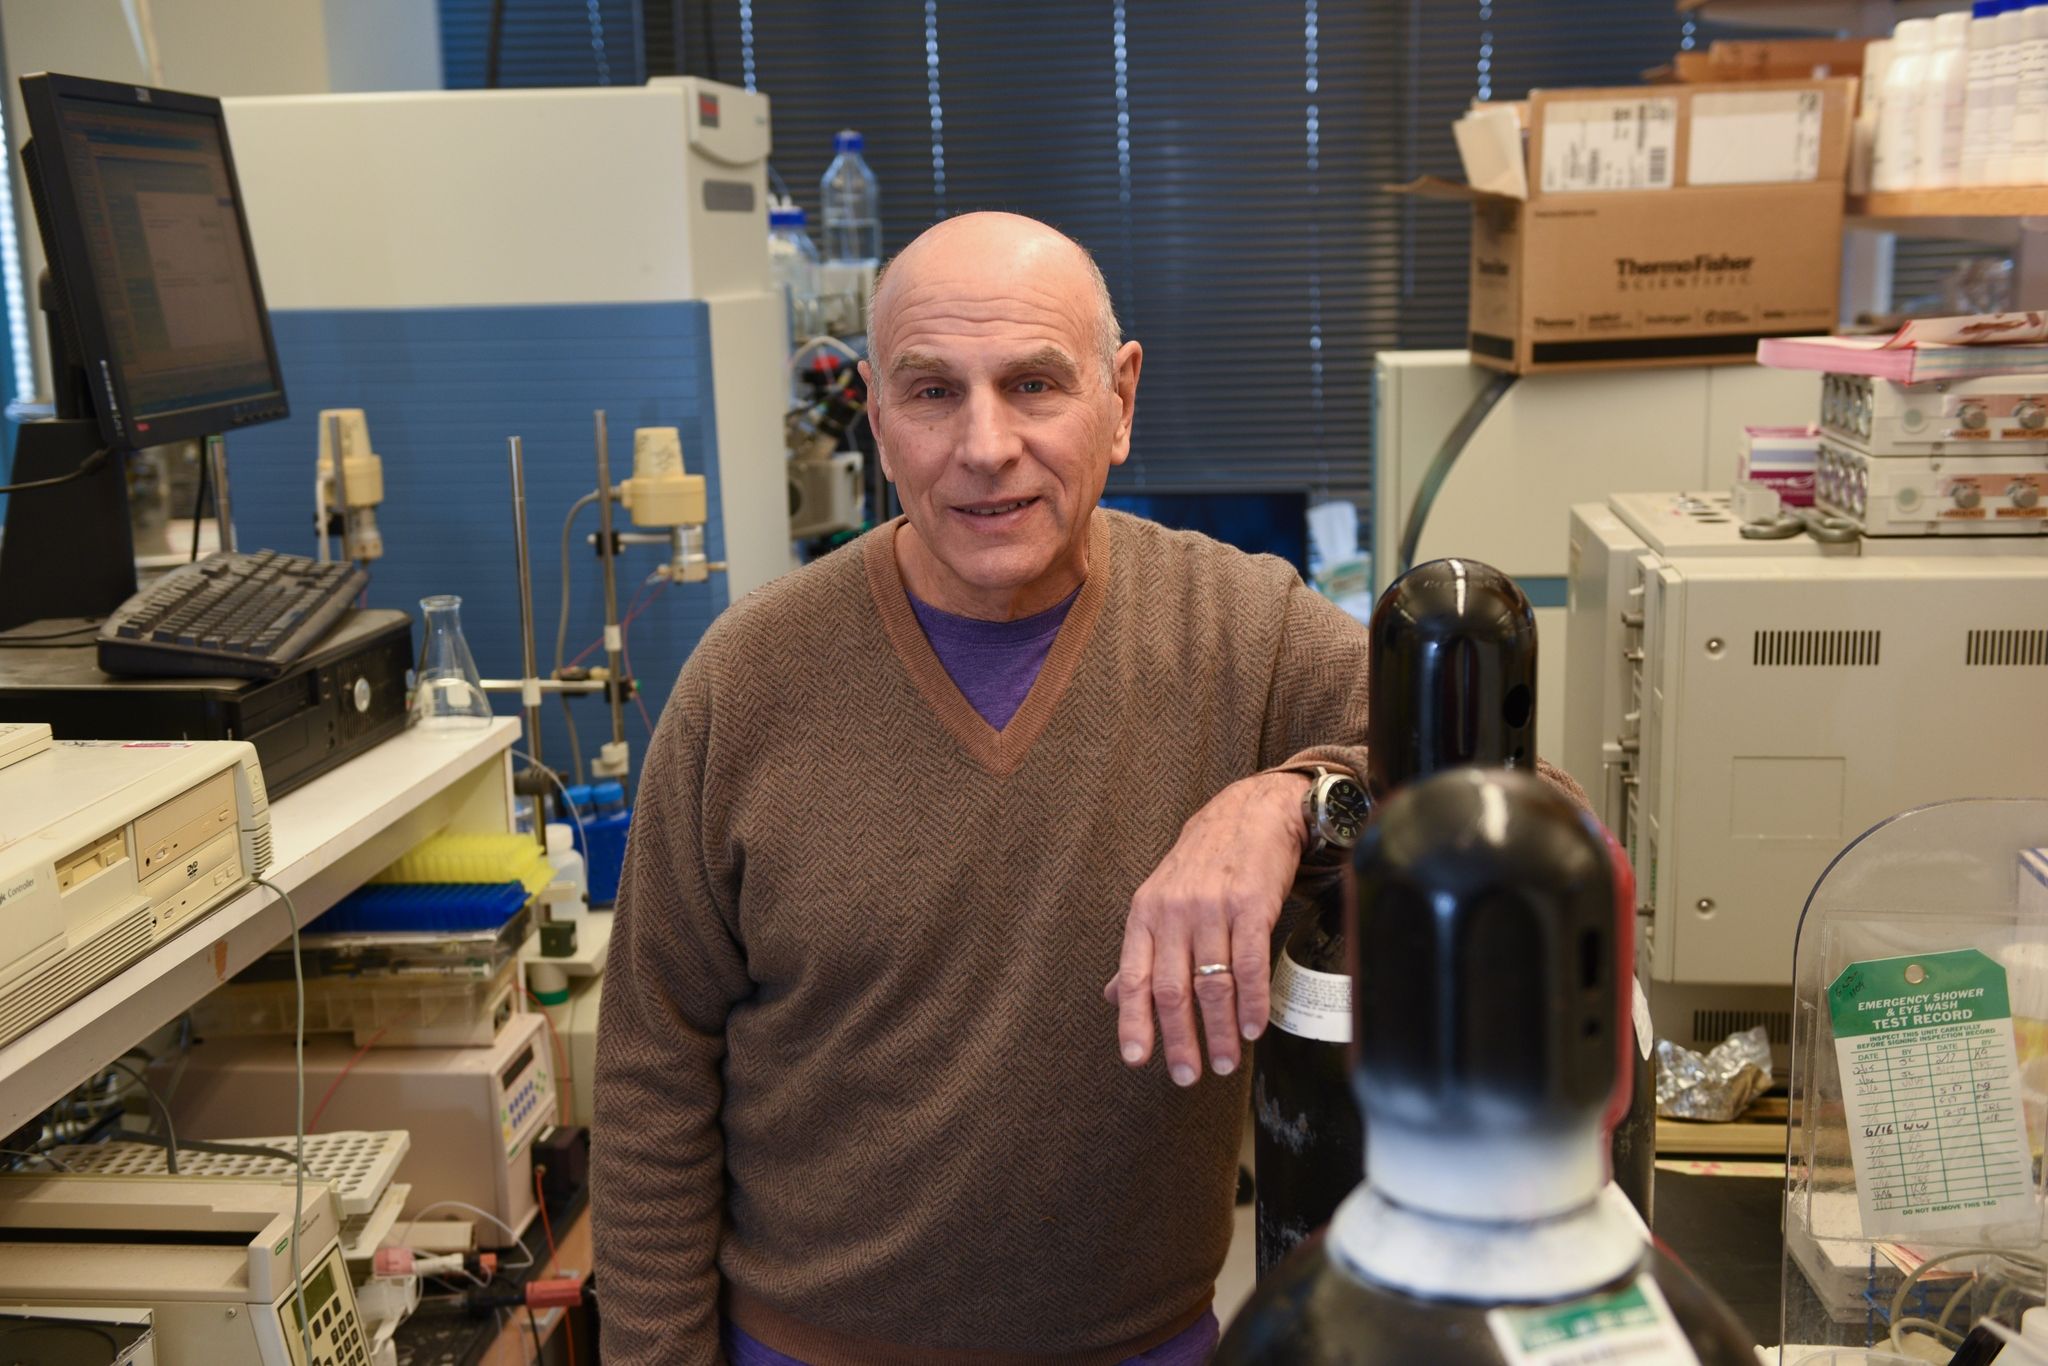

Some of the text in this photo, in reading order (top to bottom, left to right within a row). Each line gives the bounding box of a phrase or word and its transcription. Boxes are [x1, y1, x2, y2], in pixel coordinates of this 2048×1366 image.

[1615, 254, 1754, 277] ThermoFisher
[1857, 987, 1985, 1011] EMERGENCY SHOWER
[1886, 1000, 1959, 1017] & EYE WASH
[1872, 1009, 1974, 1030] TEST RECORD
[1856, 1027, 1997, 1050] BEFORE SIGNING INSPECTION RECORD
[1869, 1023, 1982, 1043] INSPECT THIS UNIT CAREFULLY
[1936, 1043, 1959, 1051] DATE
[1857, 1053, 1880, 1061] DATE
[1865, 1124, 1894, 1137] 6/16
[1902, 1199, 1998, 1216] DO NOT REMOVE THIS TAG
